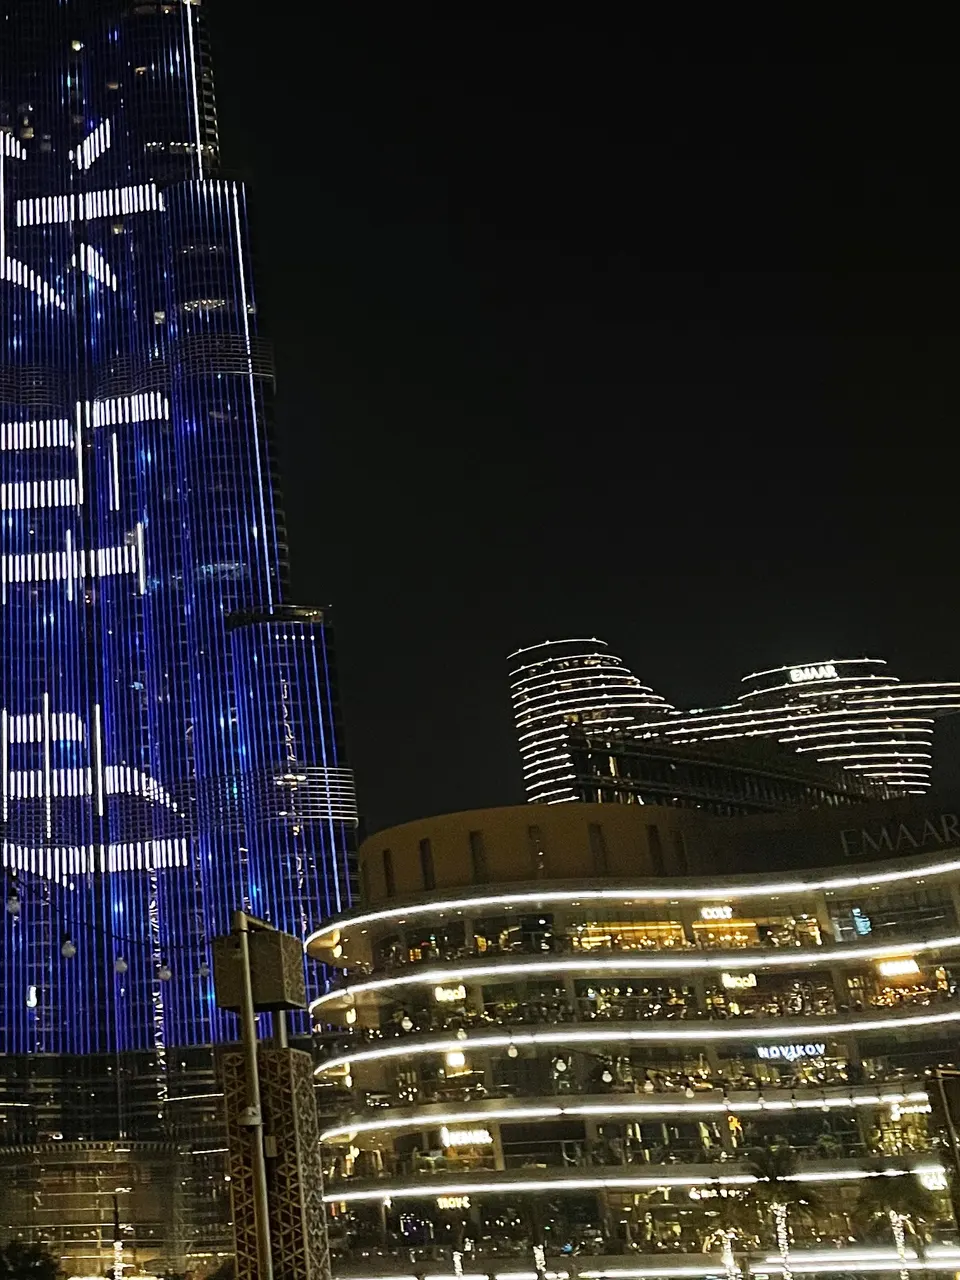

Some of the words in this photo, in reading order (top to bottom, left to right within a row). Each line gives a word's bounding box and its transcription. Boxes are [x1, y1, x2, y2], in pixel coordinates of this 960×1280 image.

[789, 665, 838, 683] EMAAR
[840, 813, 960, 857] EMAAR
[757, 1043, 826, 1059] NOVIKOV
